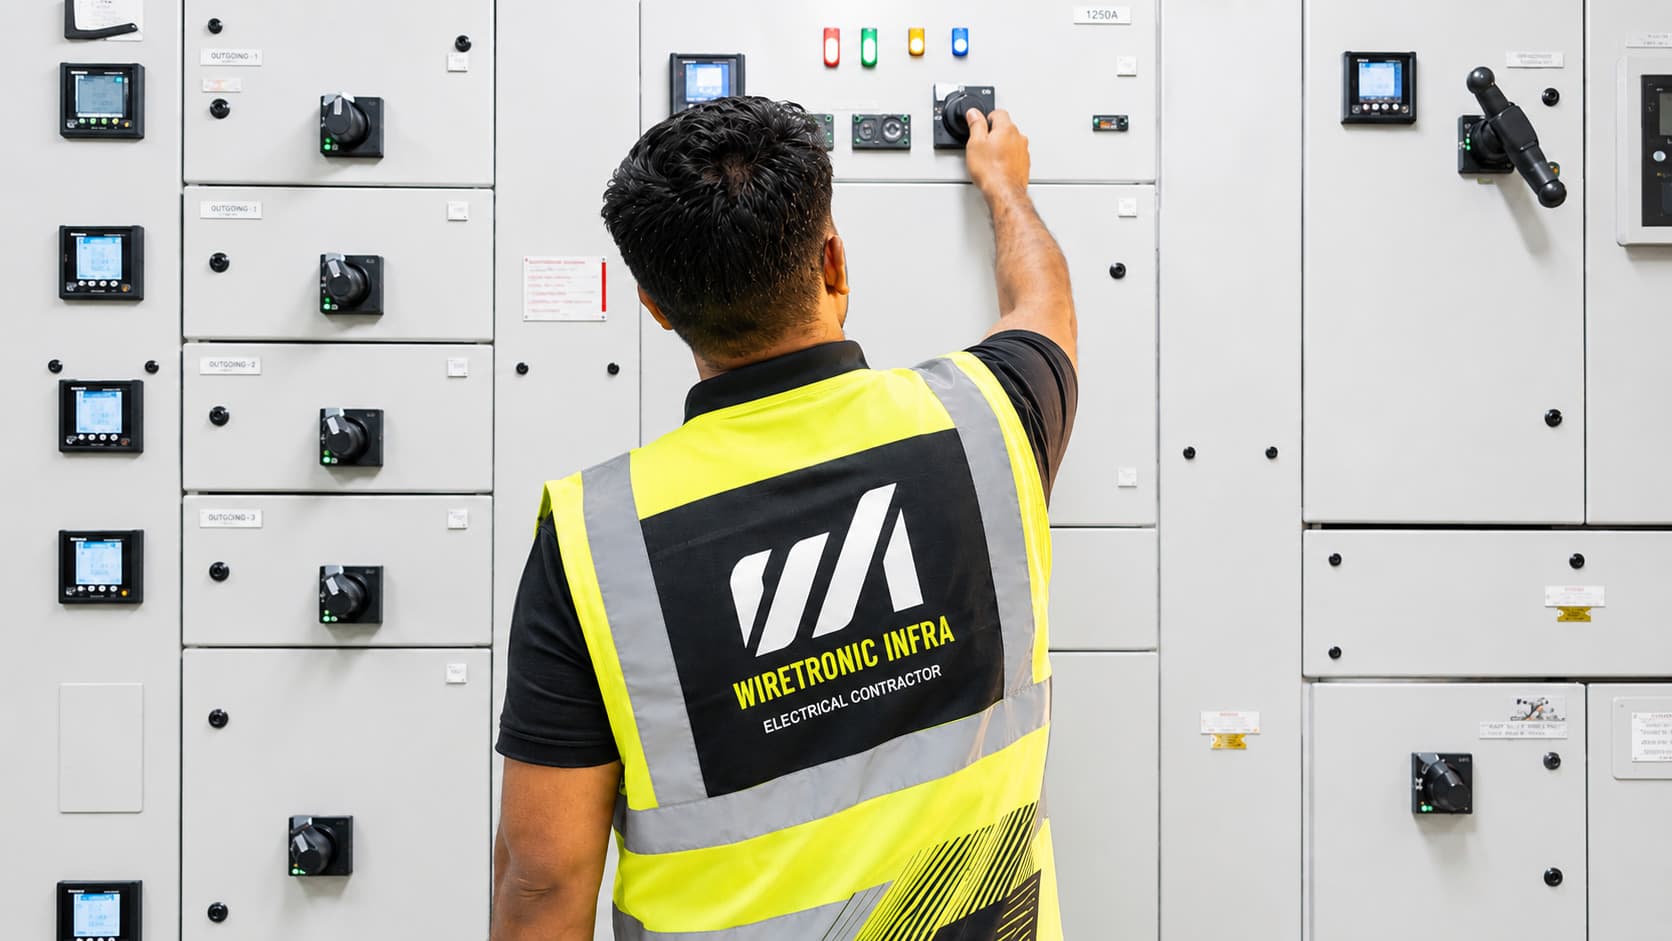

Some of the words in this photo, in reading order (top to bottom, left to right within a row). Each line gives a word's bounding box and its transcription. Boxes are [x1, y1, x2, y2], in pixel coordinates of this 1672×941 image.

[1086, 10, 1118, 20] 1250A
[211, 52, 249, 60] OUTGOING
[733, 638, 879, 711] WIRETRONIC
[883, 615, 956, 662] INFRA
[763, 694, 849, 734] ELECTRICAL
[851, 664, 942, 704] CONTRACTOR
